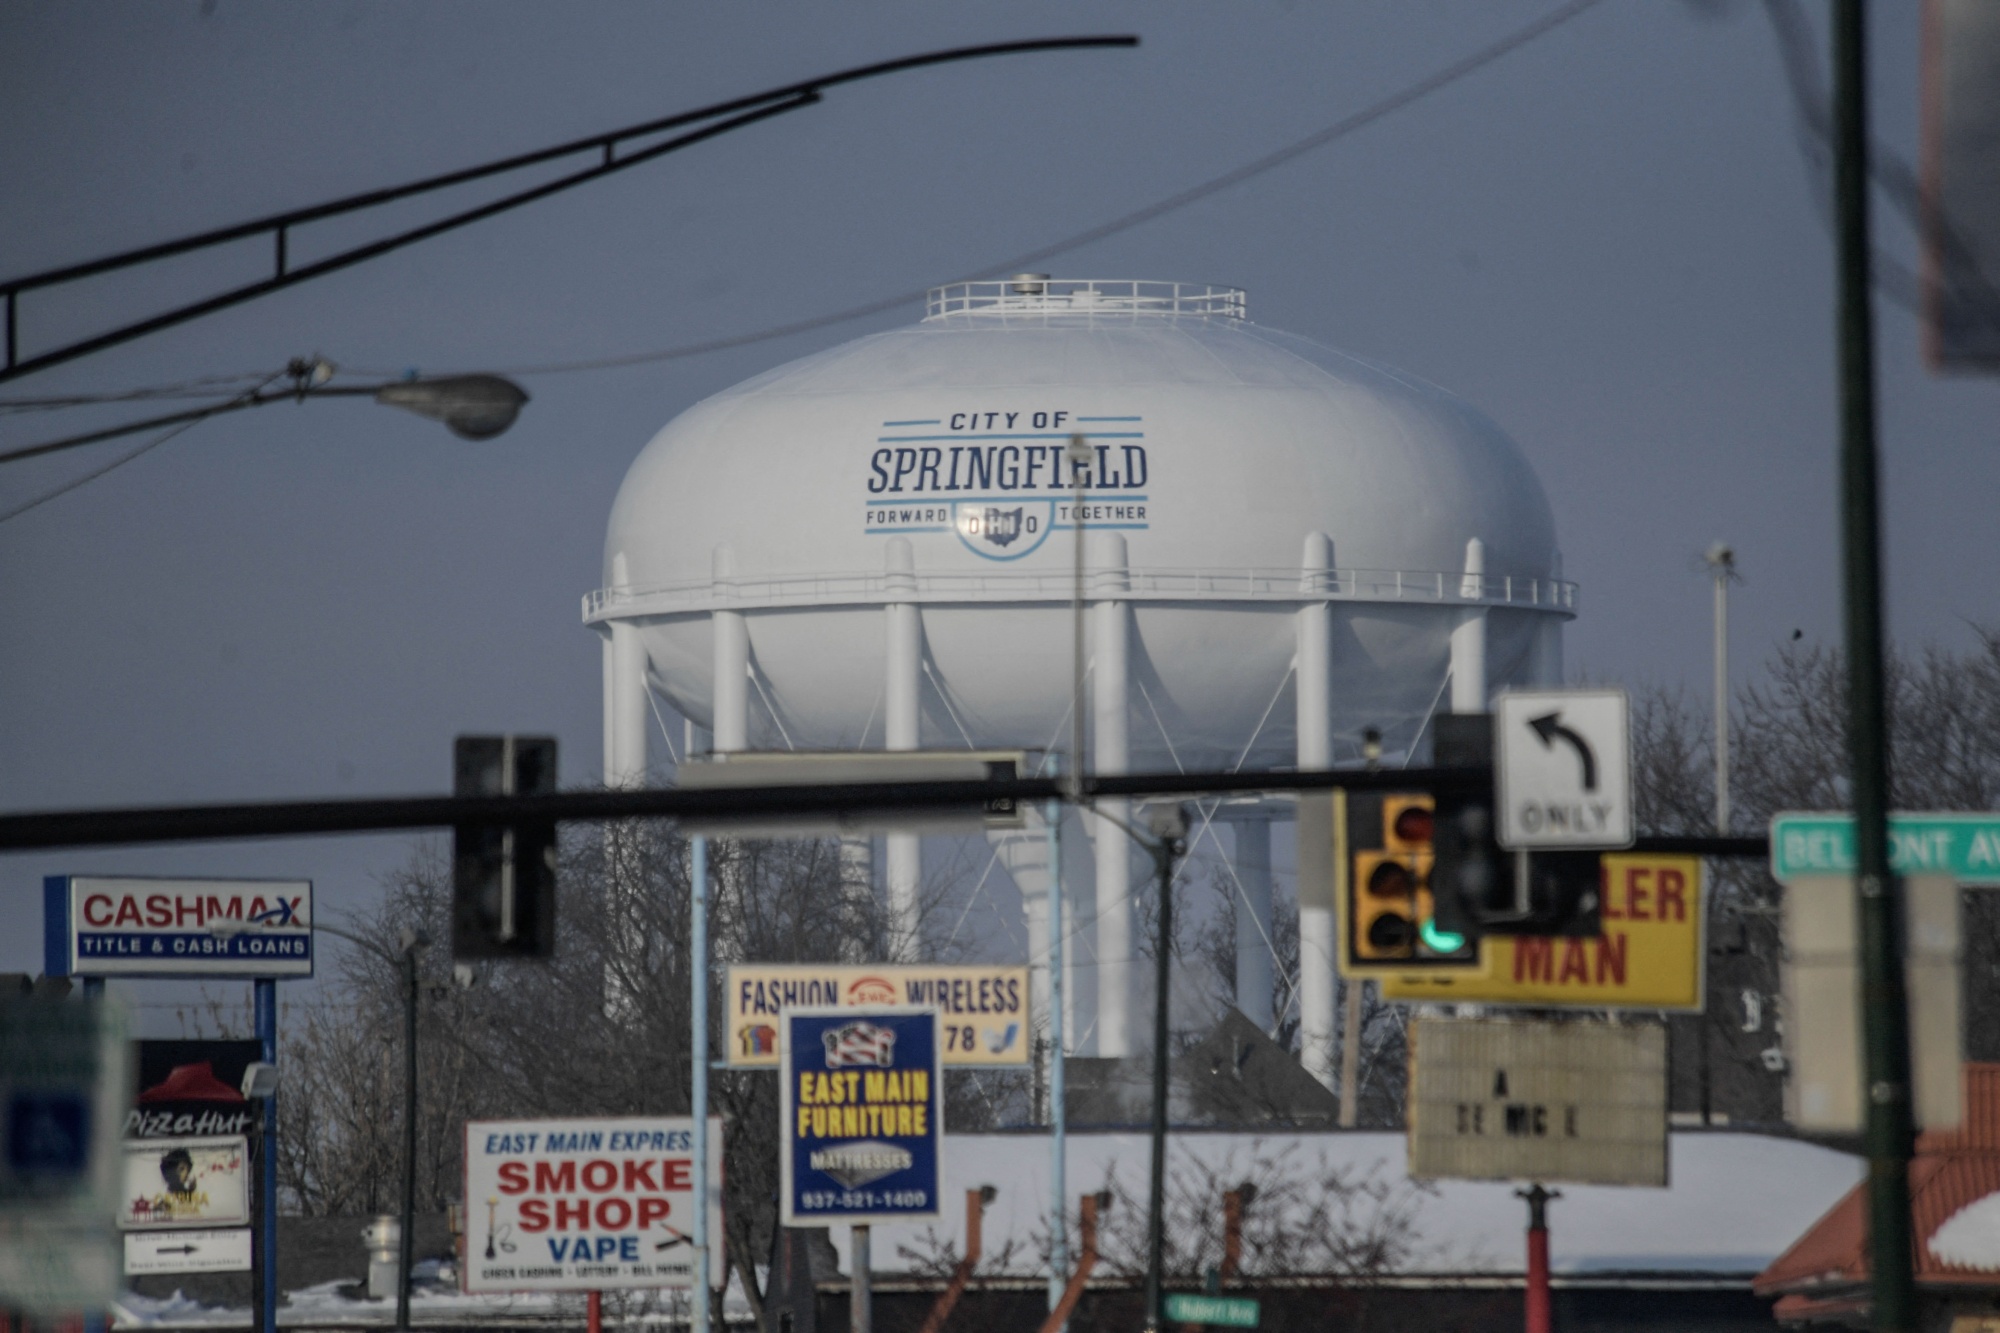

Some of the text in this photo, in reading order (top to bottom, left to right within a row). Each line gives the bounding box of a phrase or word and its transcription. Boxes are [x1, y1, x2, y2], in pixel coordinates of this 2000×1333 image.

[950, 411, 1069, 430] CITY OF
[867, 445, 1148, 493] SPRINGFIELD
[866, 506, 1147, 524] FORWARD TOGETHER
[1519, 801, 1613, 833] ONLY
[1784, 829, 1950, 869] BELONT
[84, 894, 302, 928] CASHMAX
[83, 938, 305, 955] TITLE & CASH LOANS
[1514, 932, 1628, 986] MAN
[741, 979, 838, 1014] FASHION
[906, 978, 1020, 1014] WIRELESS
[800, 1070, 929, 1104] EAST MAIN
[798, 1104, 928, 1138] FURNITURE
[485, 1131, 693, 1154] EAST MAIN EXPRES
[498, 1159, 693, 1195] SMOKE
[810, 1151, 913, 1170] MATTRESSES
[518, 1198, 671, 1233] SHOP
[547, 1236, 640, 1262] VAPE
